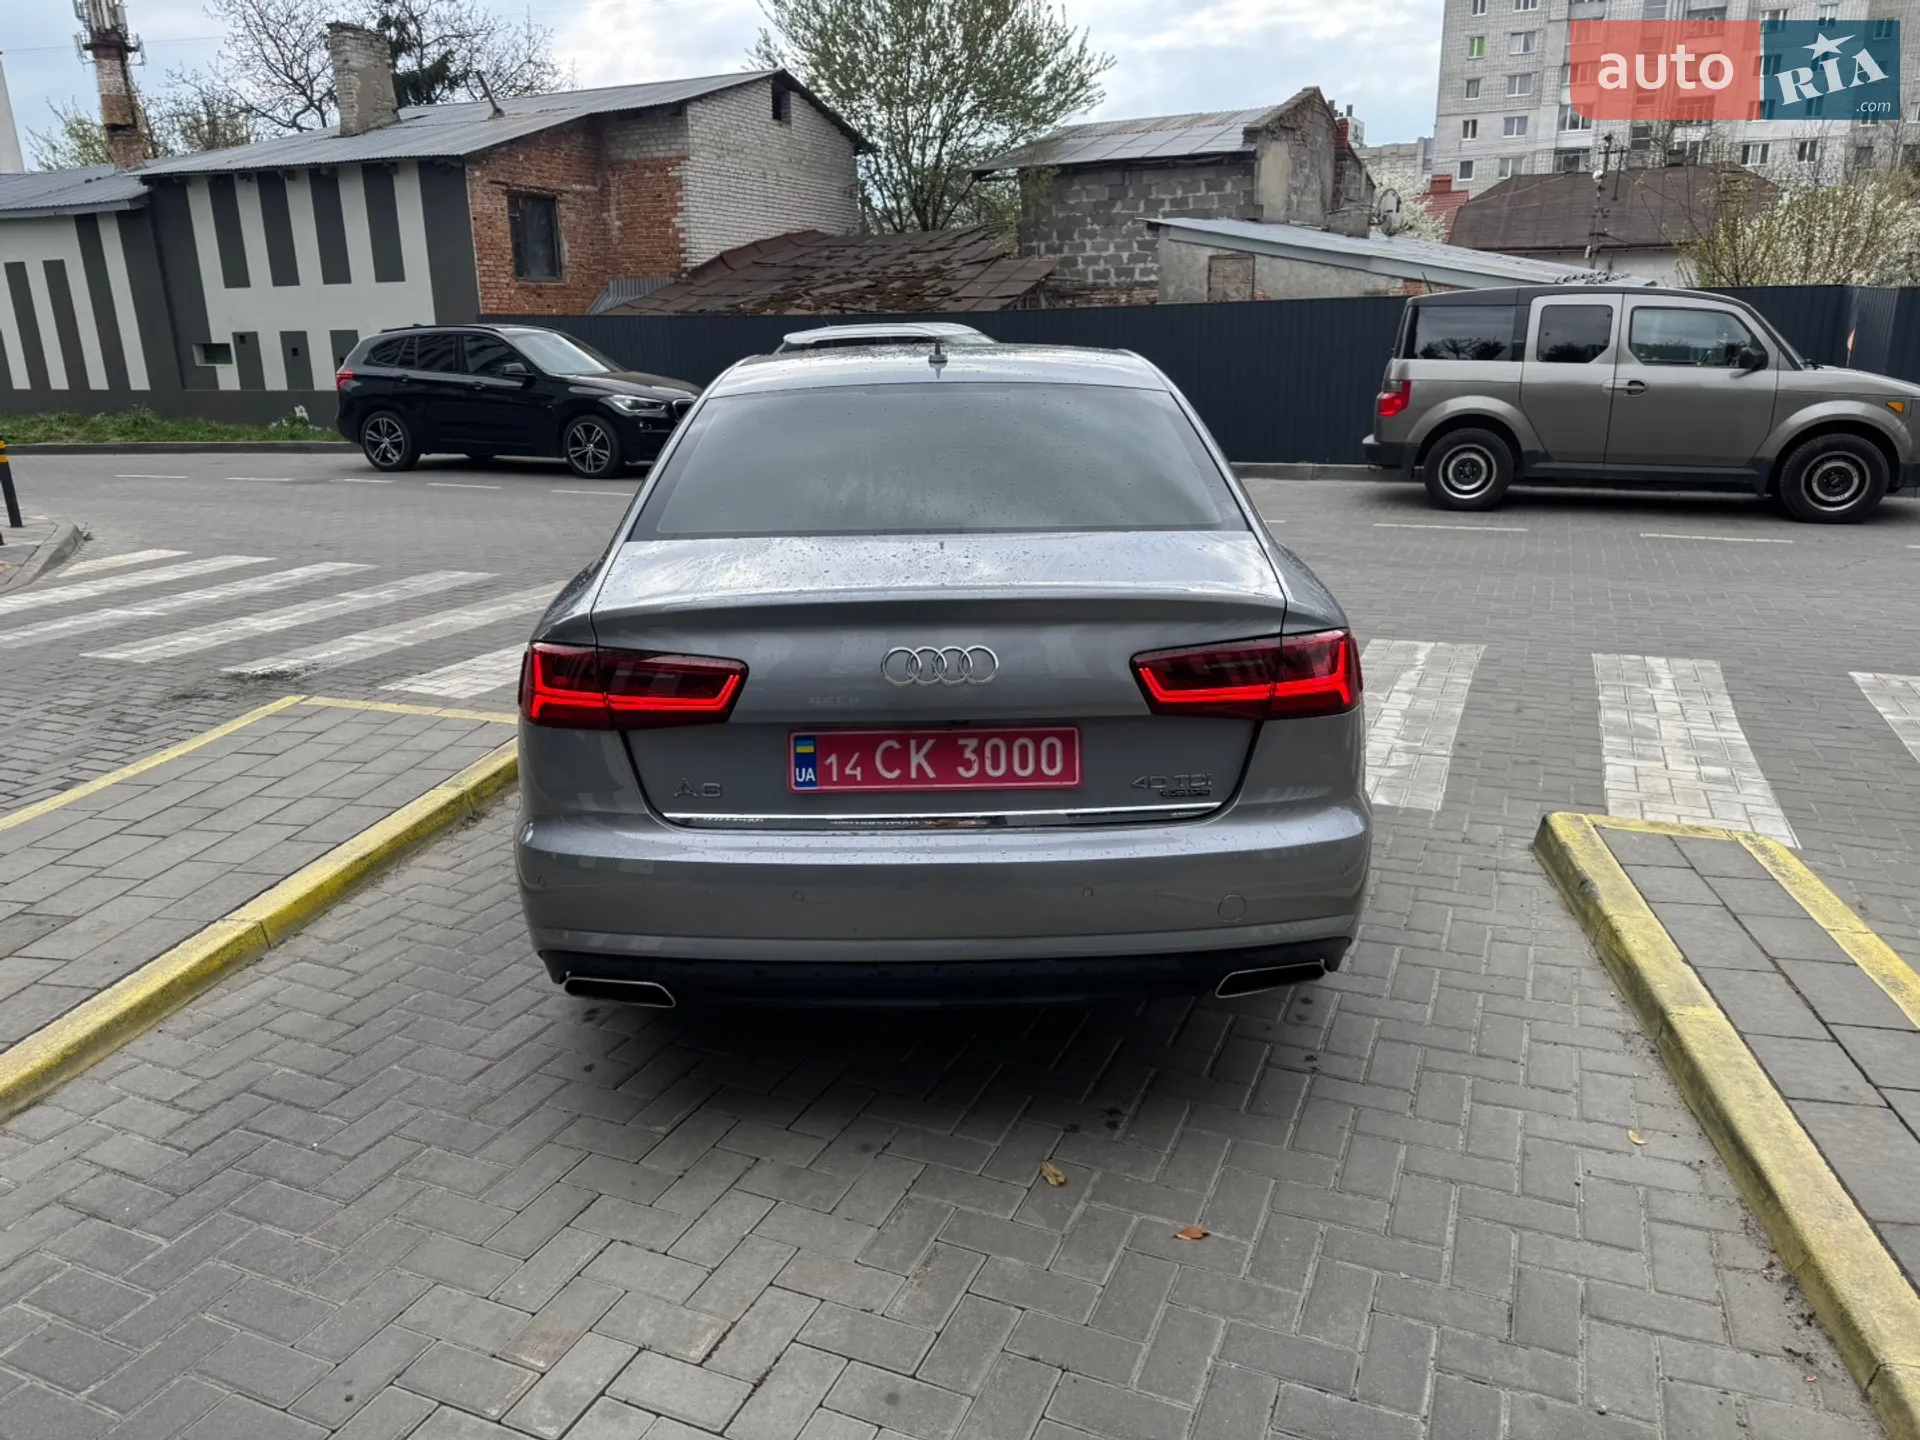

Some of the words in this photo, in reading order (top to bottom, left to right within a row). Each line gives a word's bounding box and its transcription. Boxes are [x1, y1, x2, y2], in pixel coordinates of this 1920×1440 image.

[824, 752, 862, 782] 14
[874, 739, 937, 779] CK
[956, 736, 1064, 778] 3000
[796, 767, 816, 782] UA
